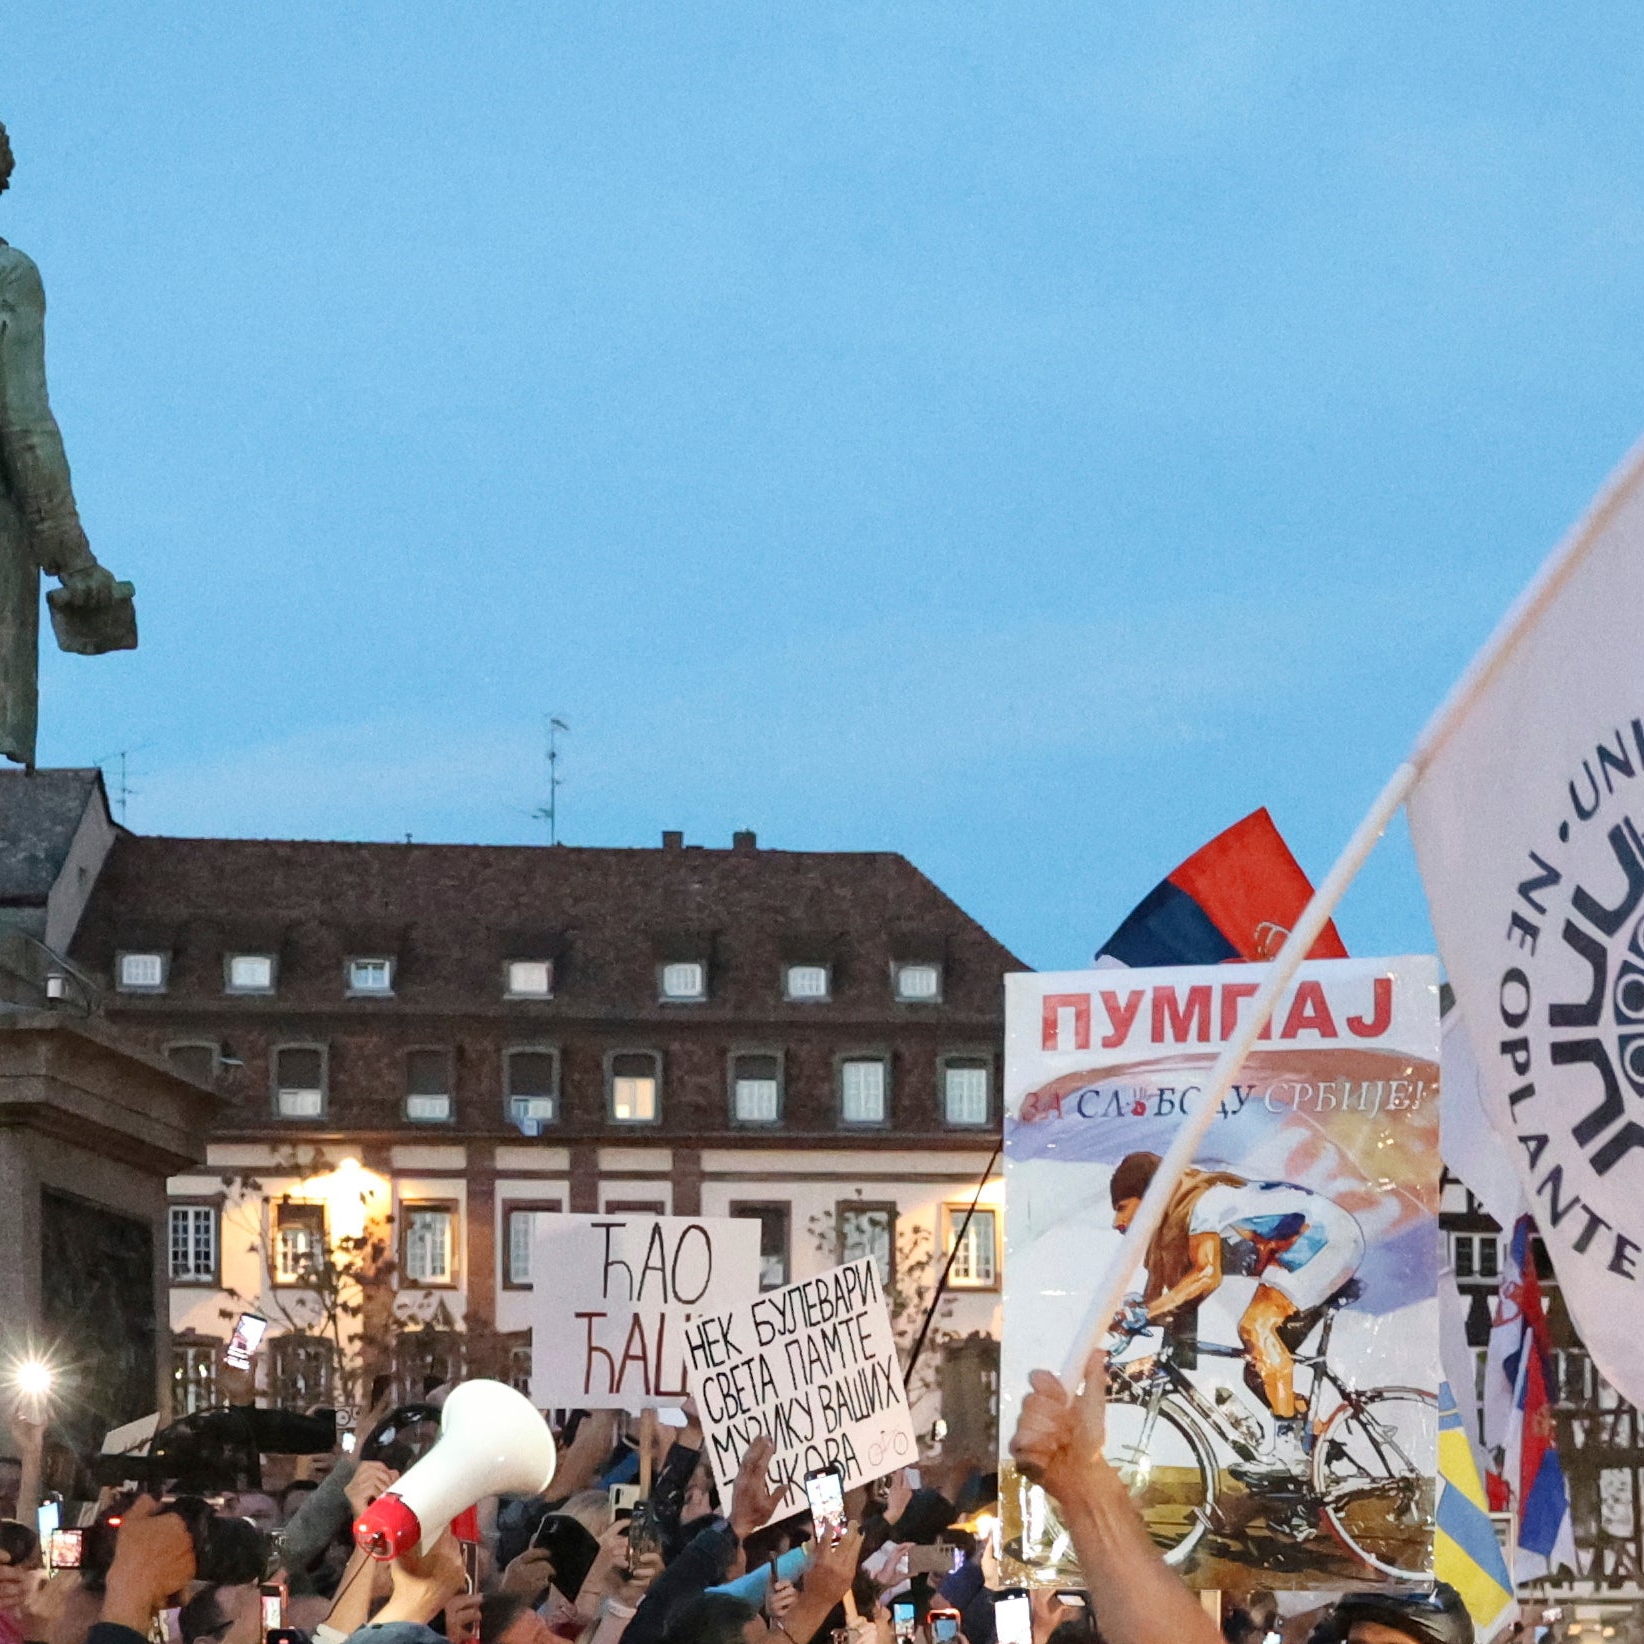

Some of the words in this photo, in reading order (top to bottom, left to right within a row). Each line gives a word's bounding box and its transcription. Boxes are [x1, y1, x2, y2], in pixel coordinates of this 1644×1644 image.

[1041, 977, 1394, 1052] ПУМПАЈ
[591, 1222, 713, 1305] ЋАО
[574, 1311, 691, 1397] ЋАЦ
[685, 1312, 743, 1371] НЕК
[751, 1259, 878, 1347] БУЛЕВАРИ
[703, 1353, 779, 1424] СВЕТА
[785, 1311, 877, 1391] ПАМТЕ
[818, 1354, 900, 1433] ВАШИХ
